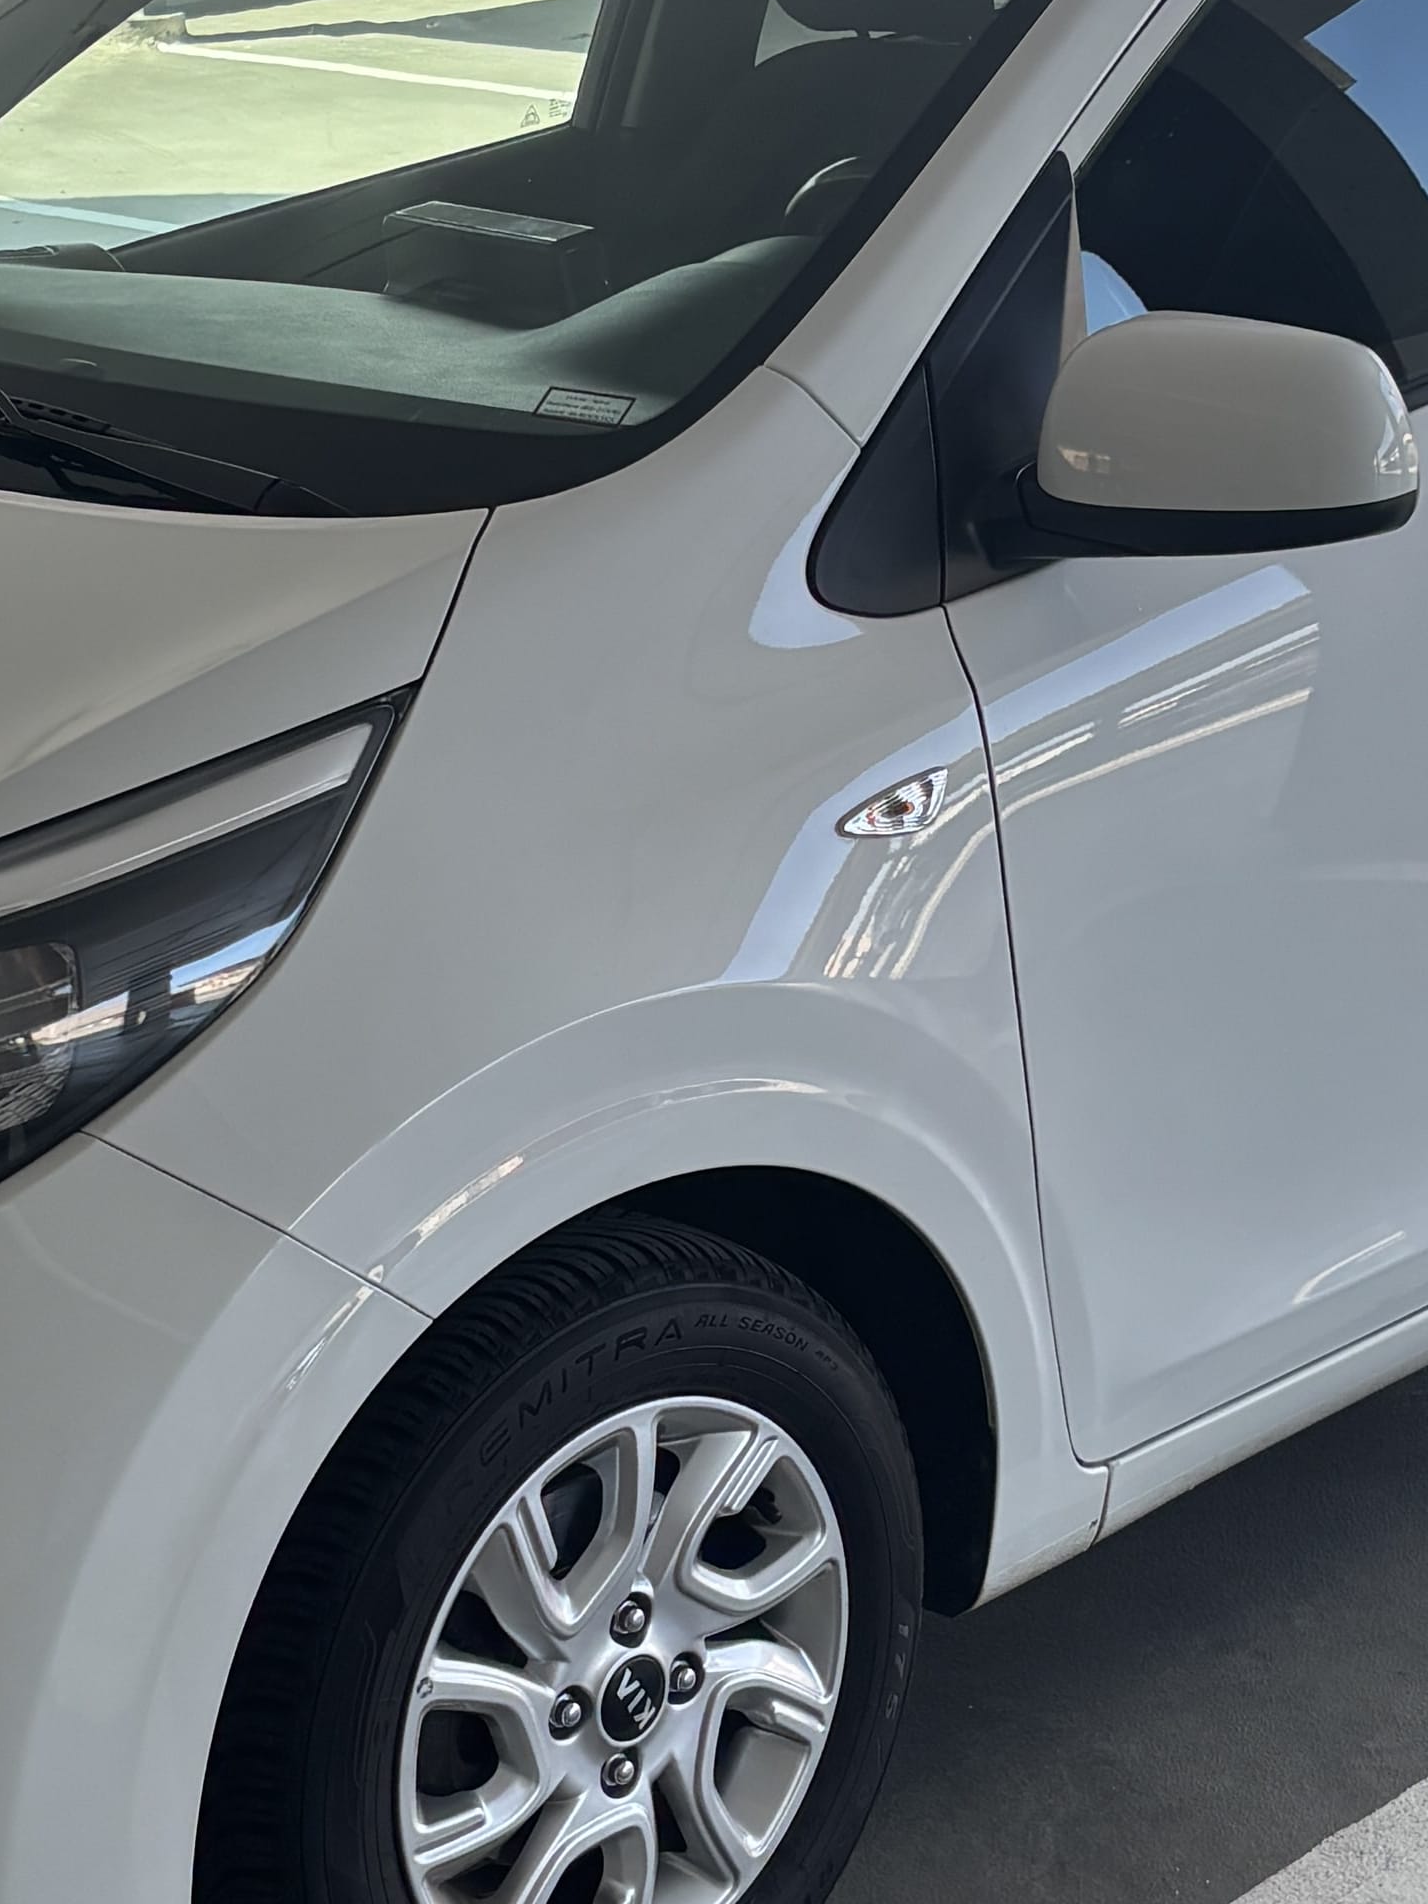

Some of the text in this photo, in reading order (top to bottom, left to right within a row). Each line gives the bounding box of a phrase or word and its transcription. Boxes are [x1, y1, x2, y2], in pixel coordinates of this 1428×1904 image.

[467, 1318, 682, 1480] EMITRA
[694, 1313, 729, 1328] ALL
[738, 1316, 810, 1352] SEASON
[616, 1667, 656, 1730] KIA
